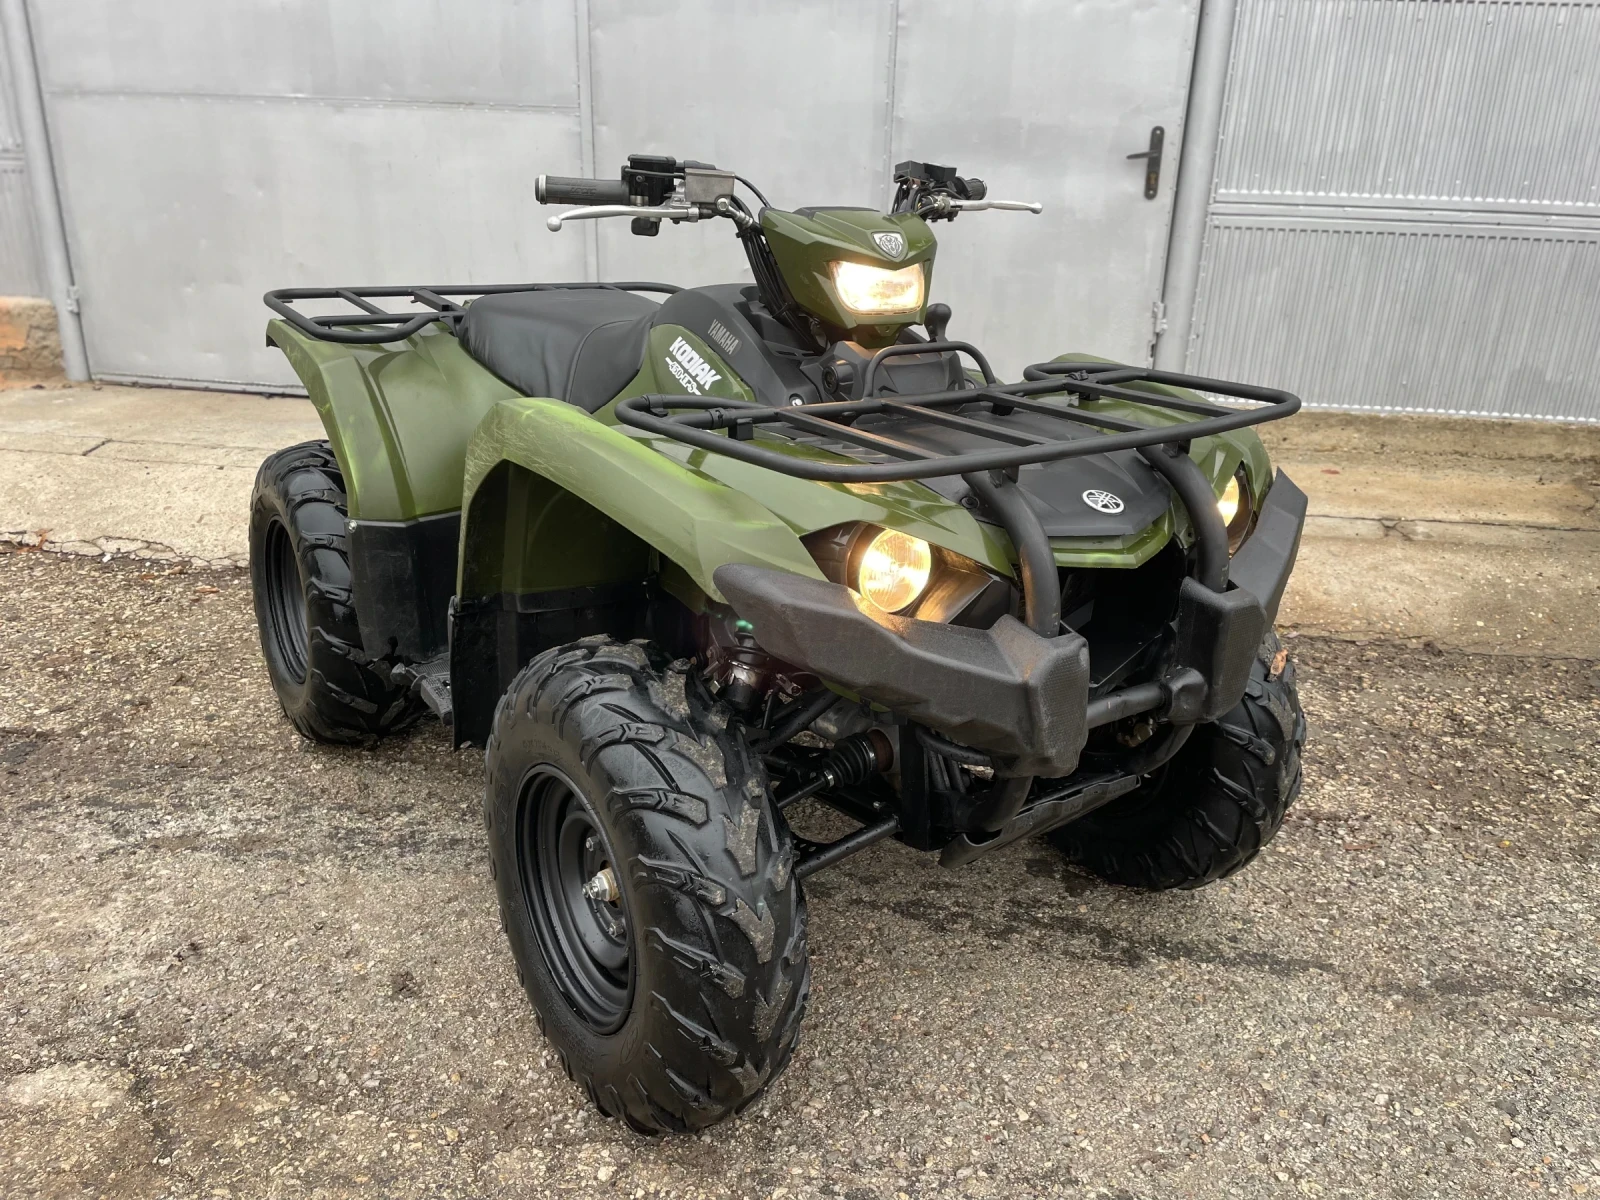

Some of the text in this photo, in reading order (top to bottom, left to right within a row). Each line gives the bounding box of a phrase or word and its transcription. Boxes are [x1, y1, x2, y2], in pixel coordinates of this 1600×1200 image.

[708, 319, 739, 355] YAMAHA
[669, 336, 722, 391] KODIAK
[669, 362, 696, 392] 450 EPS
